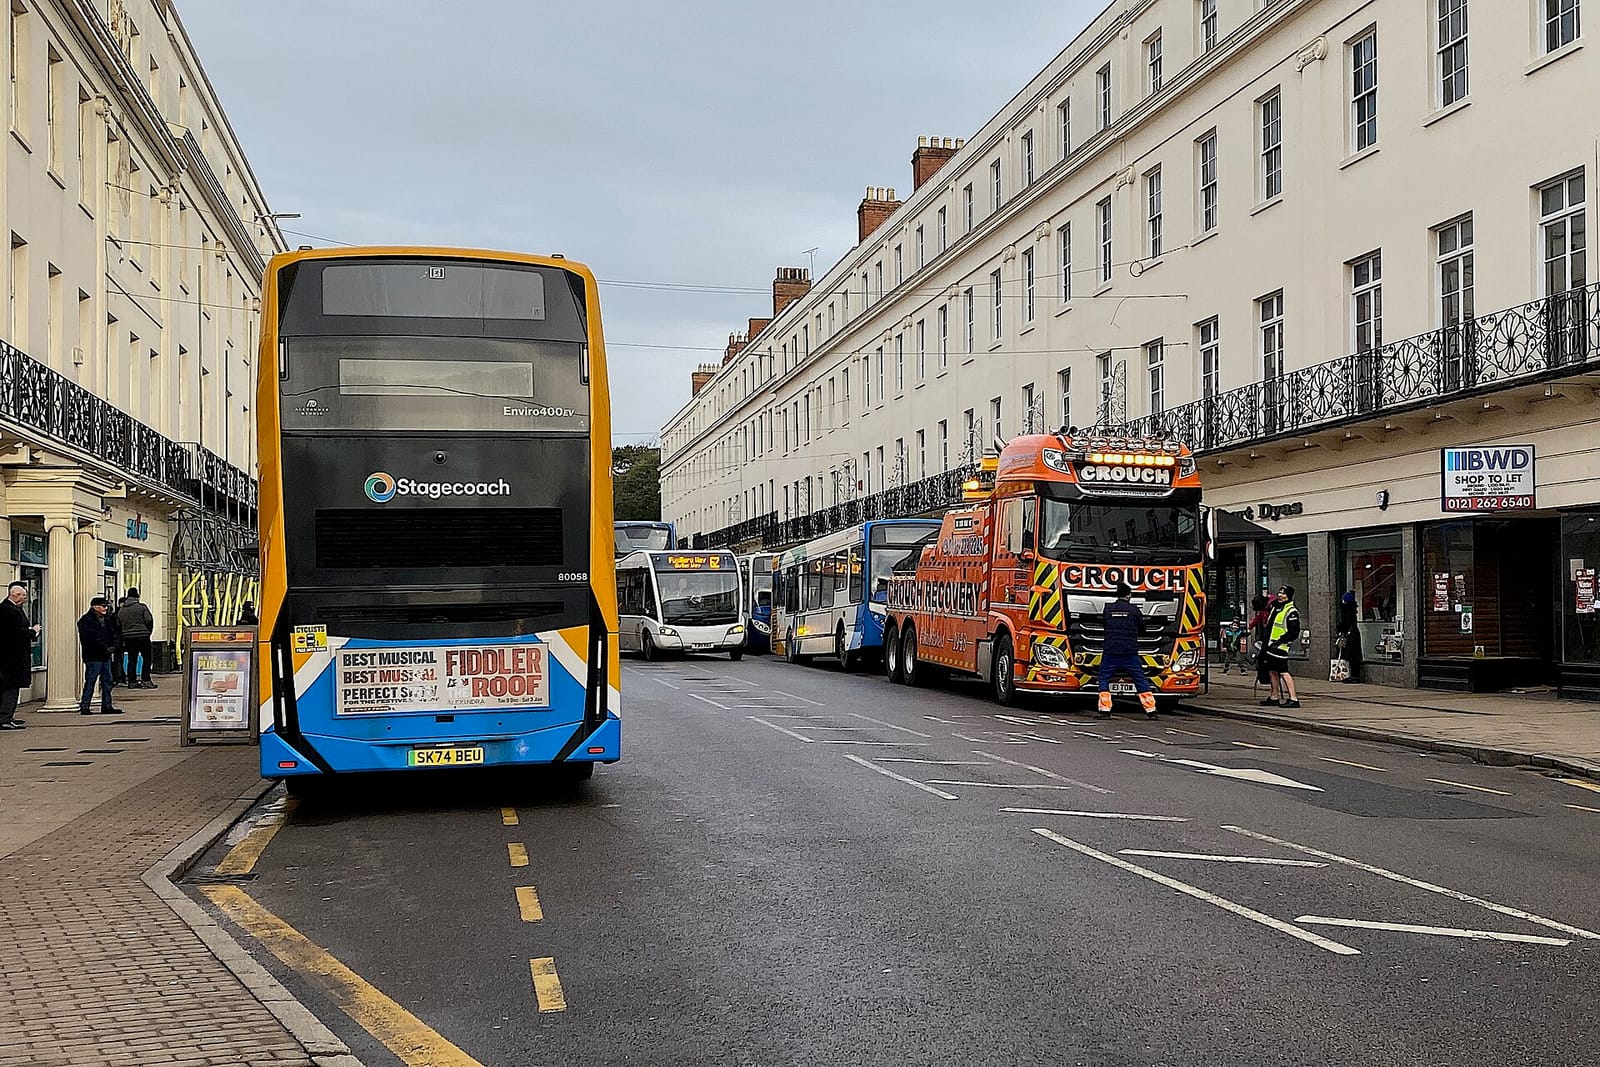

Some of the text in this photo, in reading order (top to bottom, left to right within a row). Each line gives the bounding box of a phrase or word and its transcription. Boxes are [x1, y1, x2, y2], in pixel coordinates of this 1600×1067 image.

[503, 406, 575, 417] Enviro400EV
[1468, 450, 1529, 470] BWD
[1080, 466, 1170, 484] CROUCH
[1455, 474, 1522, 484] SHOP TO LET
[397, 478, 510, 498] Stagecoach
[1448, 497, 1530, 508] 0121 262 6540
[1258, 502, 1303, 521] Dyas
[710, 556, 720, 568] 62
[558, 573, 588, 581] 80058
[1062, 566, 1185, 590] CROUCH
[887, 581, 981, 616] CROUCH RECOVERY
[343, 651, 437, 666] BEST MUSICAL
[446, 648, 542, 676] FIDDLER
[343, 670, 376, 684] BEST
[379, 668, 437, 683] MUSIAL
[472, 675, 542, 698] ROOF
[417, 750, 481, 763] SK74 BEU
